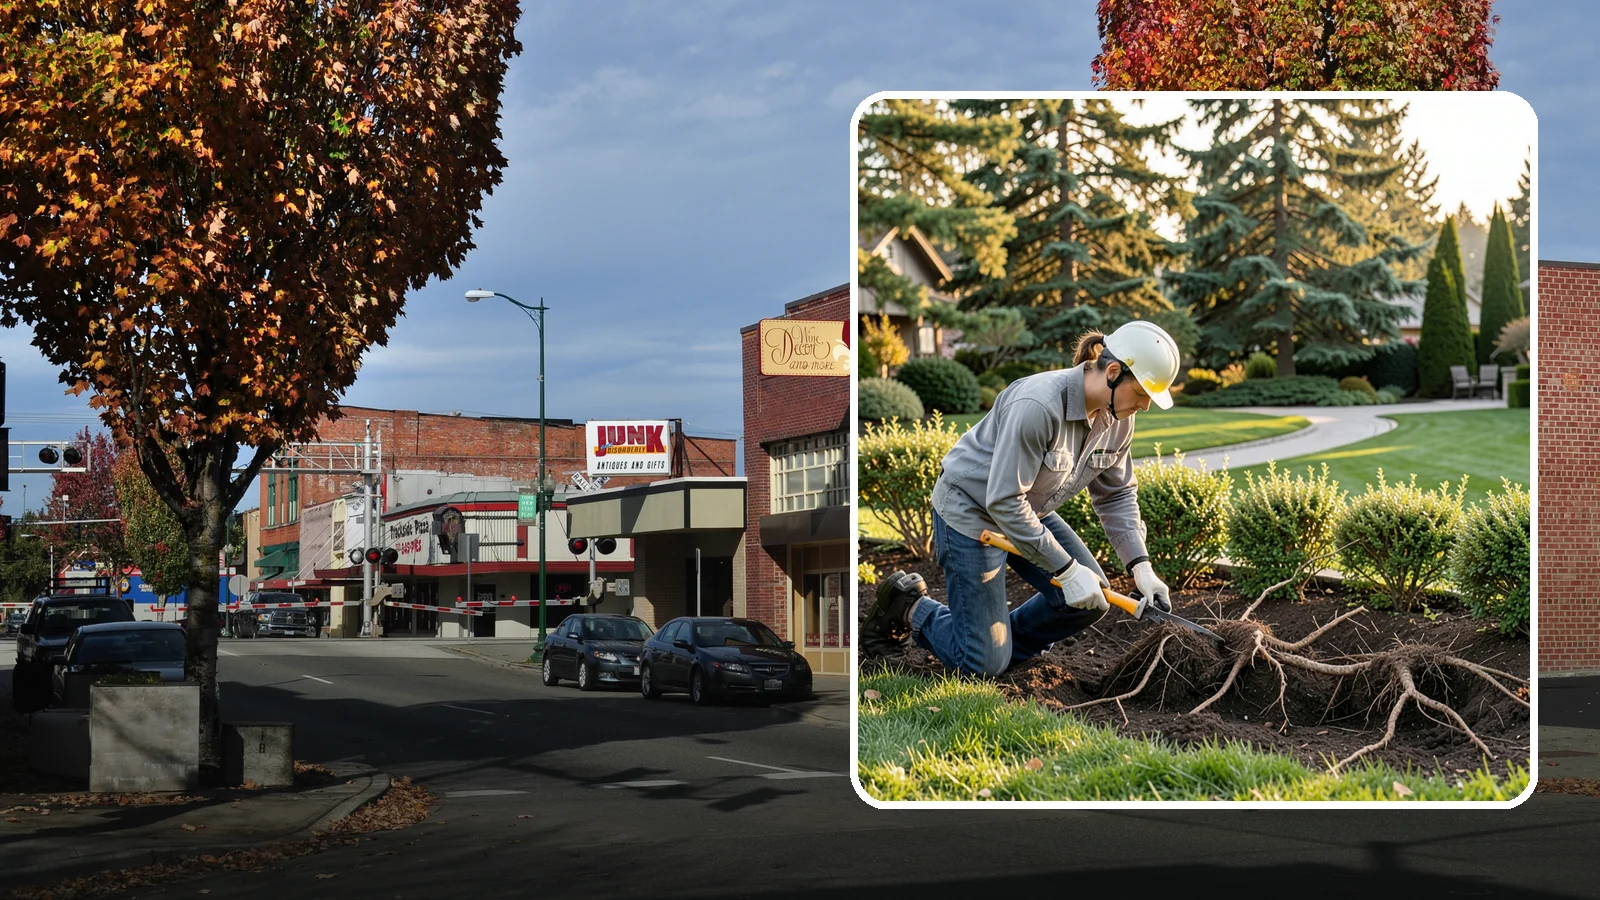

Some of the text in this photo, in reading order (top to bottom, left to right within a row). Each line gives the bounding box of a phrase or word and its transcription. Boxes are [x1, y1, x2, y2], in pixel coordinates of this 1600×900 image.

[596, 425, 665, 457] JUNK
[607, 446, 646, 454] DISORDERLY
[597, 460, 665, 470] ANTIQUES AND GIFTS
[390, 520, 429, 539] Trackside Pizza
